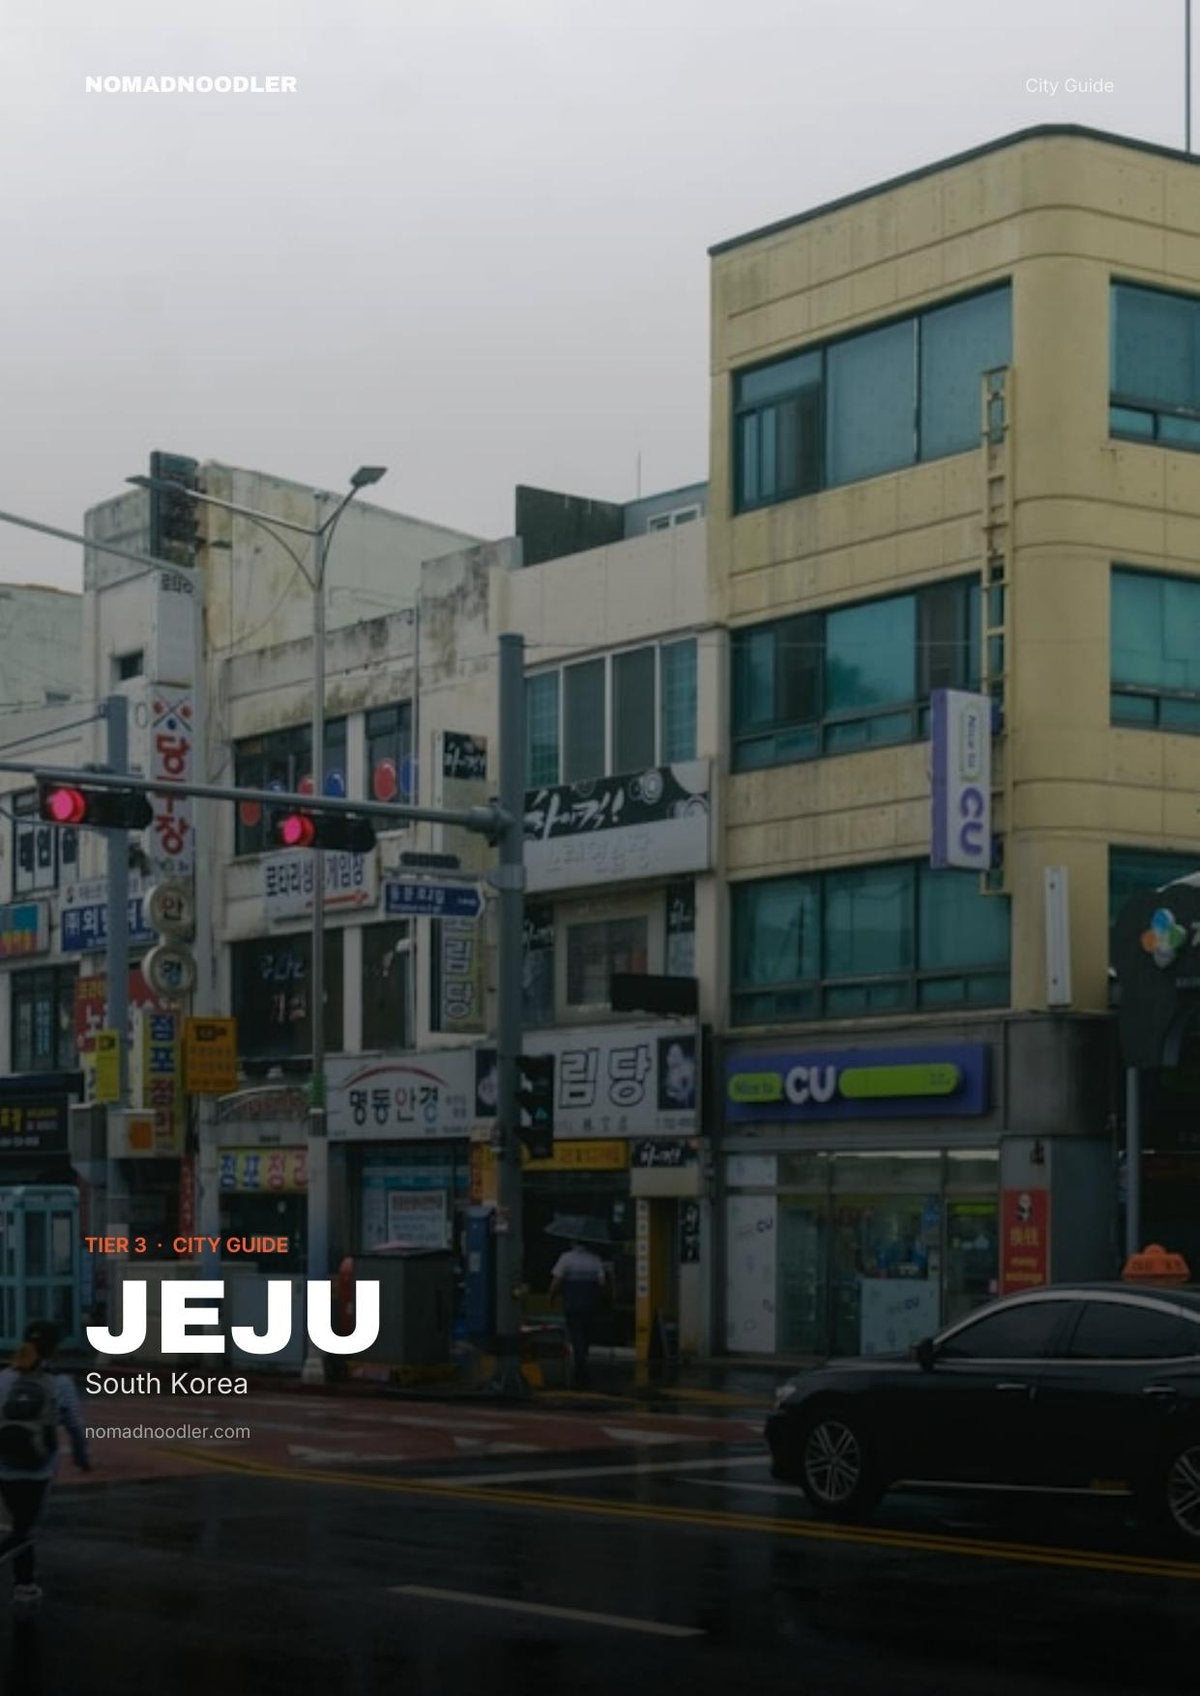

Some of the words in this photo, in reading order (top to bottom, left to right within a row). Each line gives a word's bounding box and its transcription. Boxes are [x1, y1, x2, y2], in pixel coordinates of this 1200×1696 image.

[960, 787, 984, 856] CU
[785, 1066, 835, 1104] CU
[349, 1086, 438, 1126] 명동안경
